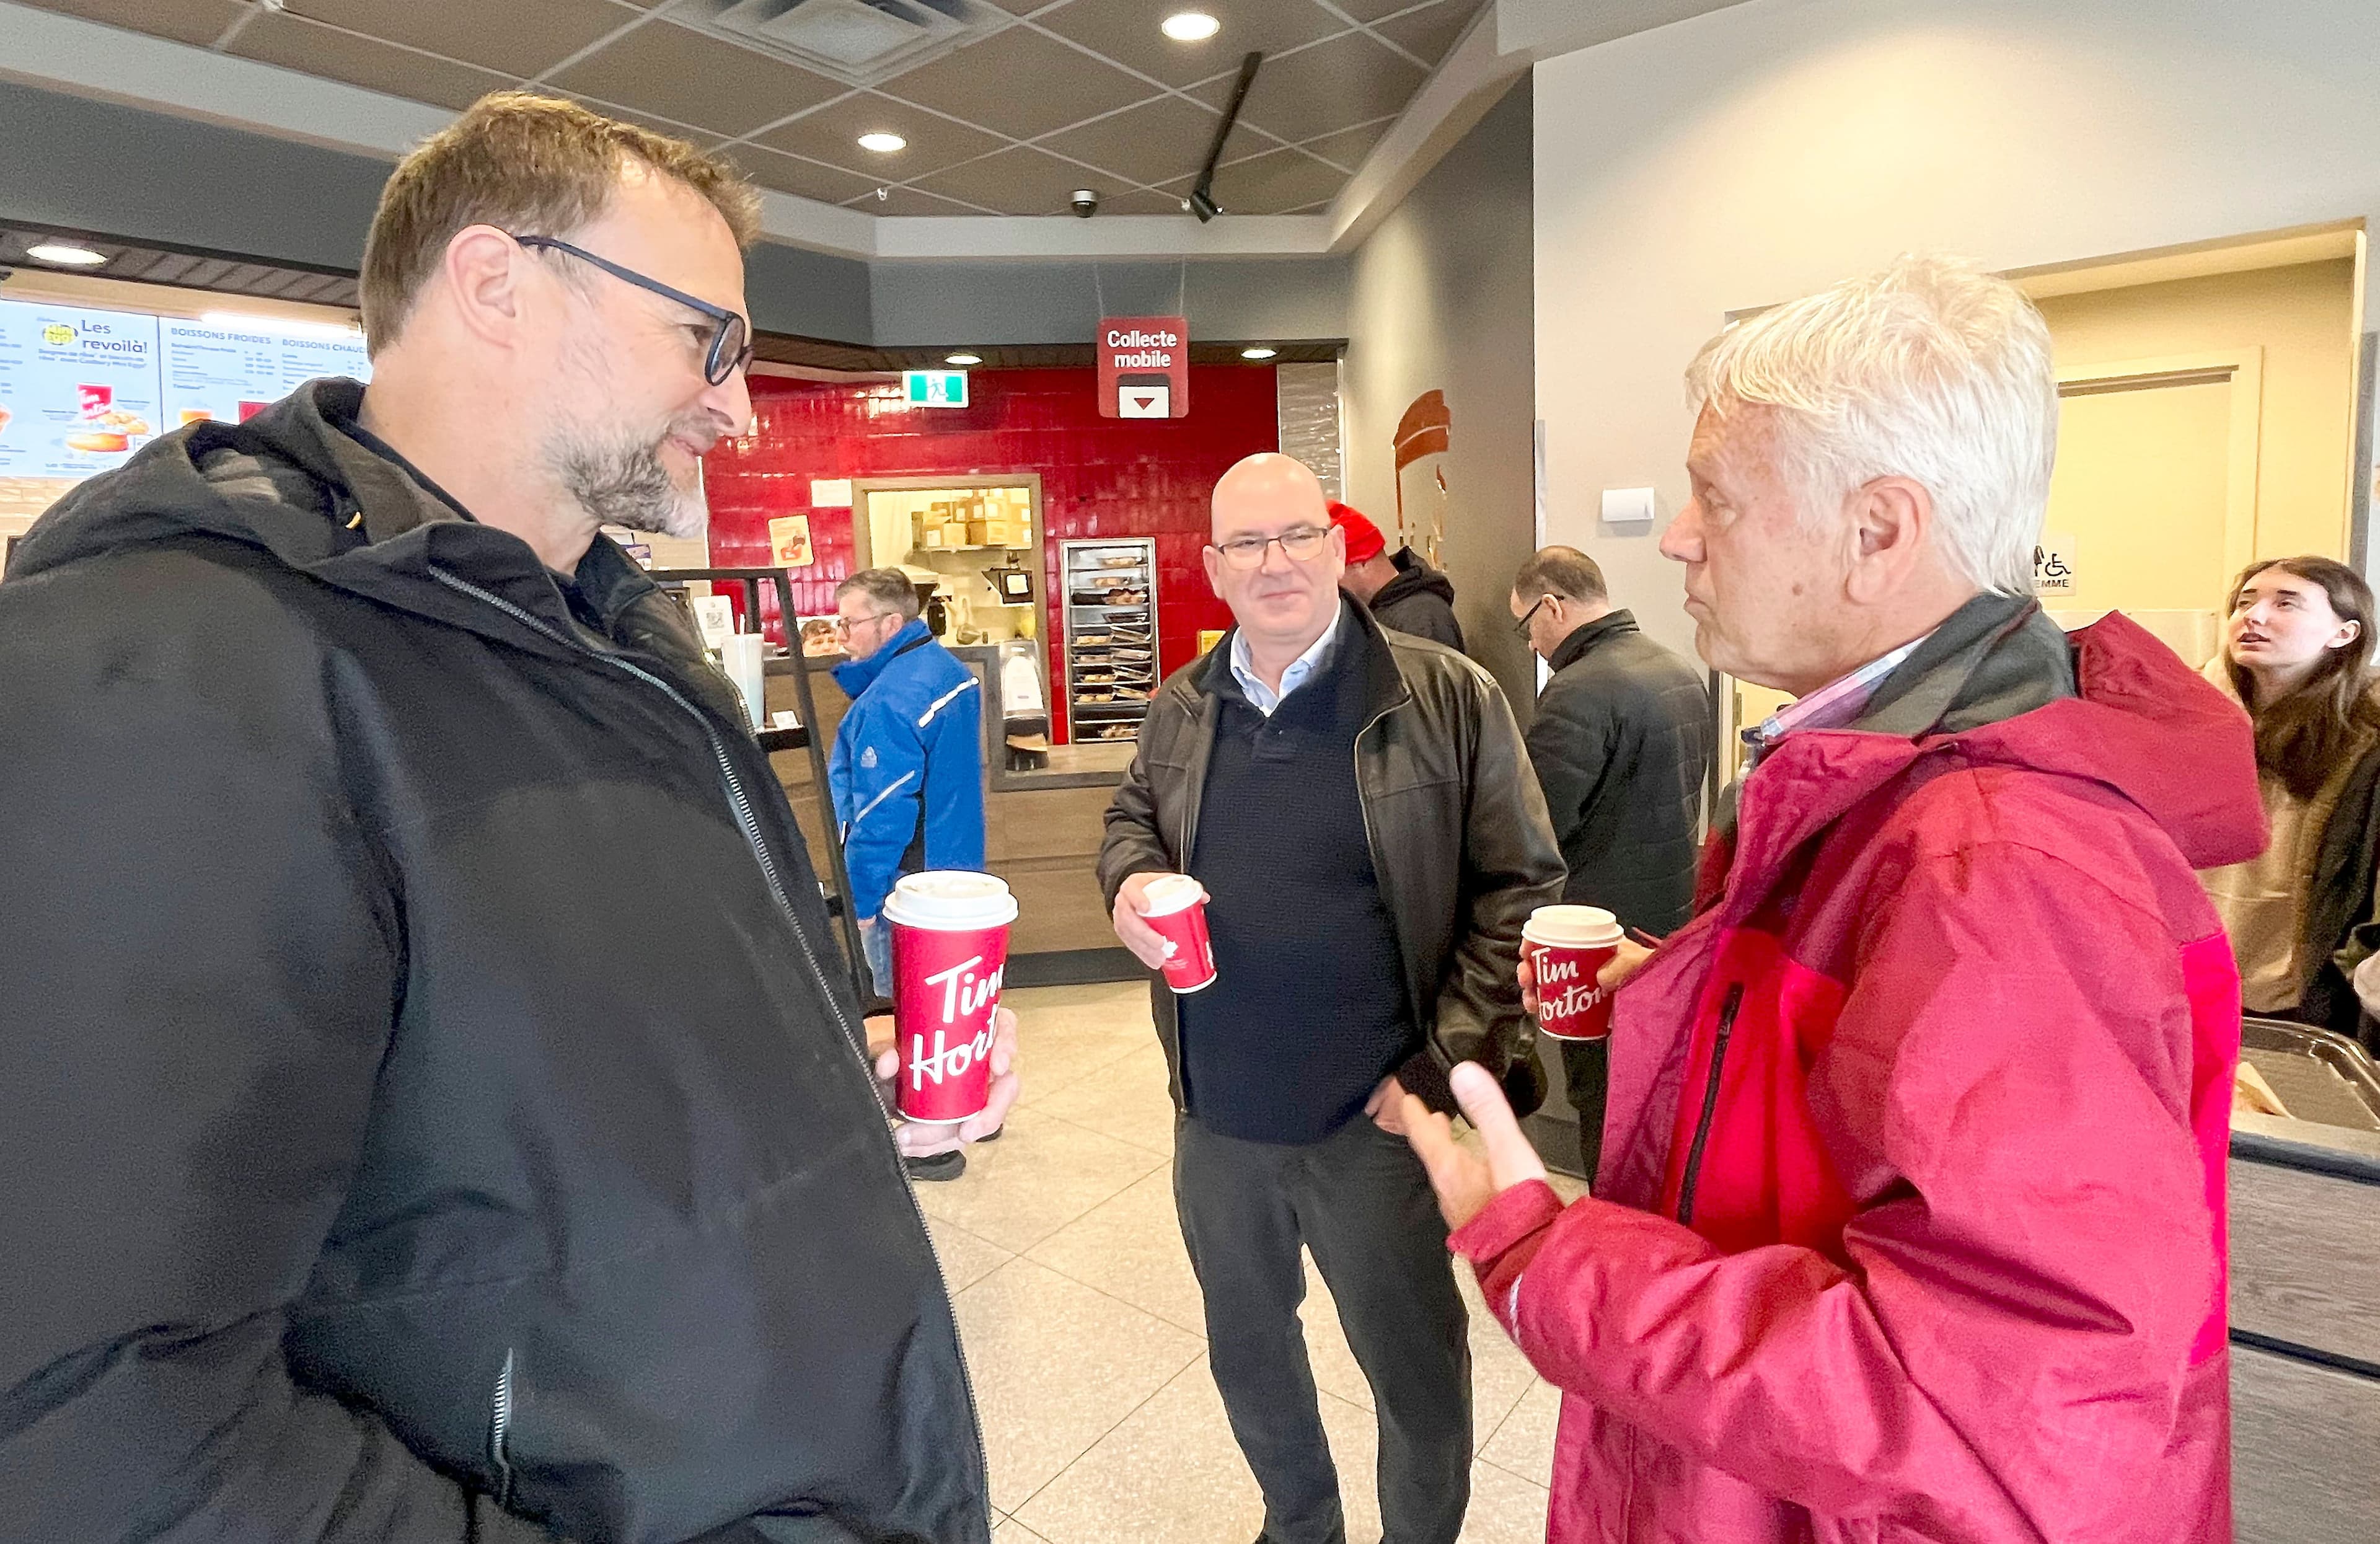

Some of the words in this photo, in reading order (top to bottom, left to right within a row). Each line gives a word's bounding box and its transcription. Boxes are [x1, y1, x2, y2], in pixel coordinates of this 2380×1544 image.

[81, 320, 111, 334] Les
[171, 328, 225, 340] BOISSONS
[228, 333, 271, 344] FROIDES
[1107, 330, 1178, 348] Collecte
[82, 340, 148, 353] revoilà!
[282, 339, 330, 350] BOISSONS
[332, 344, 367, 353] CHAUD
[1114, 350, 1171, 368] mobile
[2034, 579, 2069, 588] EMME
[1531, 946, 1579, 984] Tim
[925, 955, 1004, 1023] Tim
[909, 1002, 998, 1092] Hort
